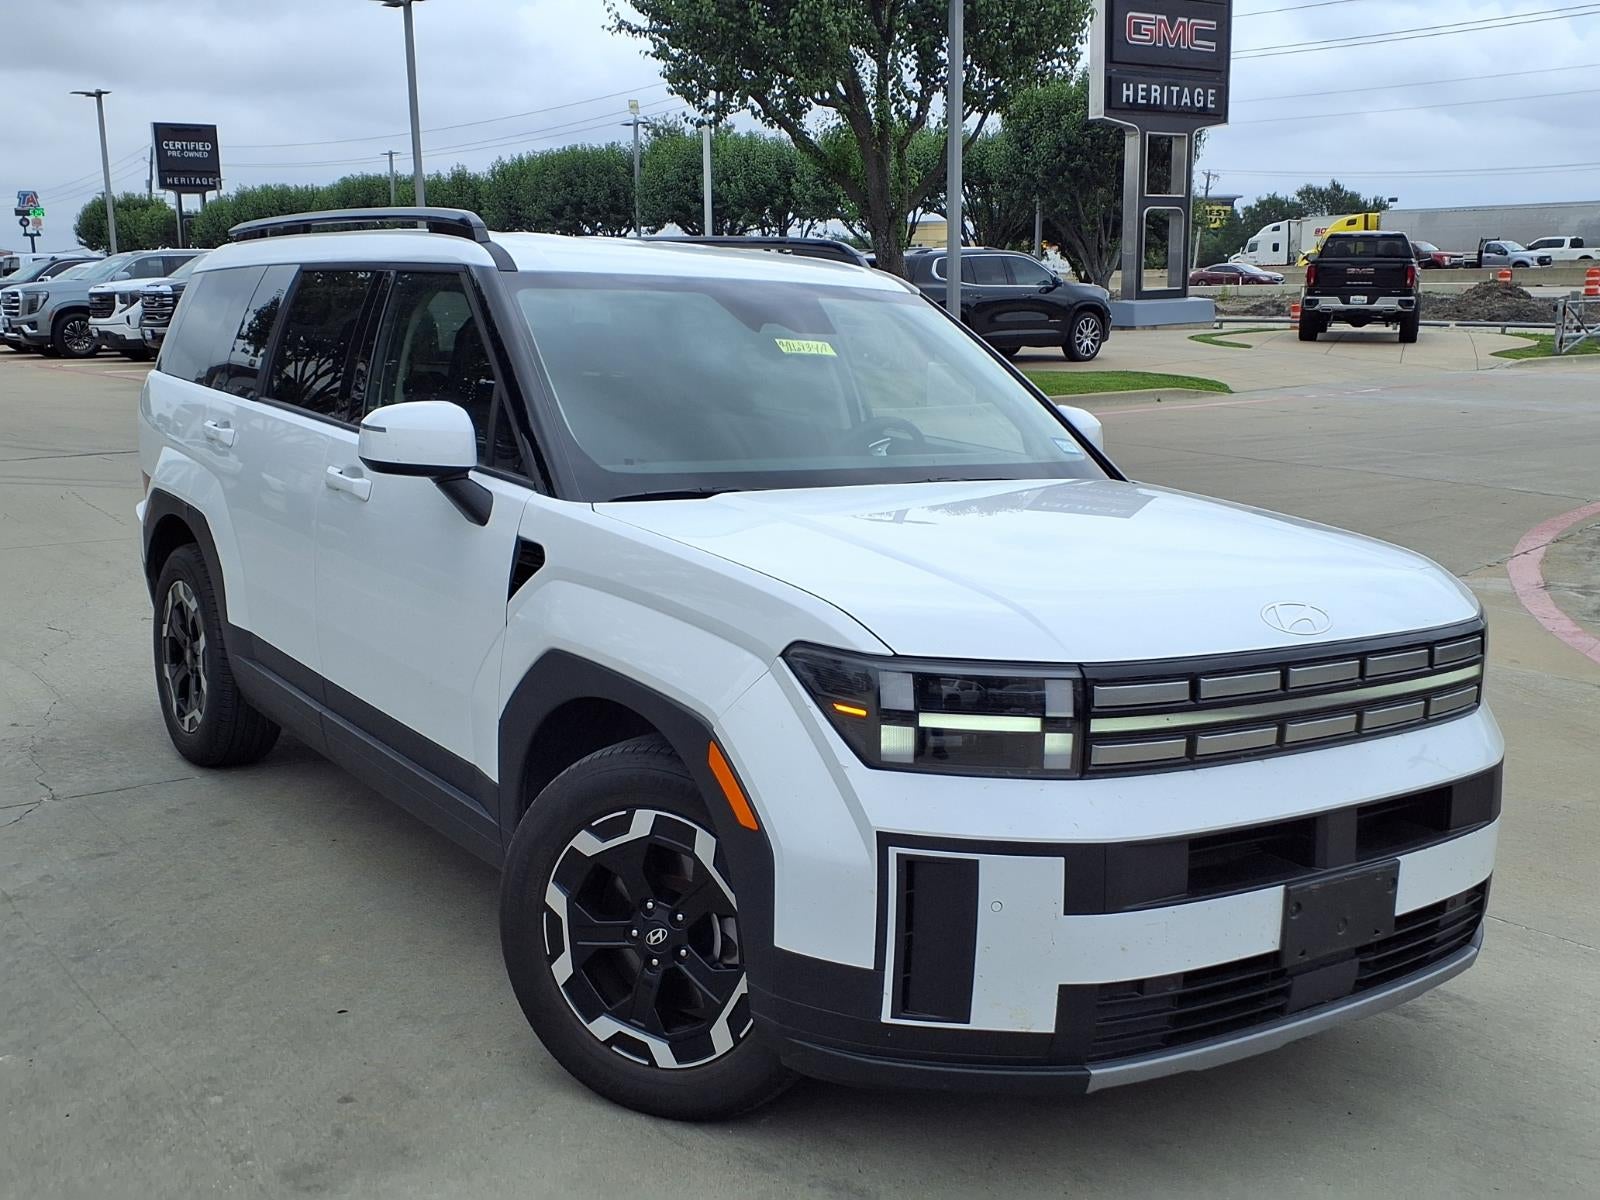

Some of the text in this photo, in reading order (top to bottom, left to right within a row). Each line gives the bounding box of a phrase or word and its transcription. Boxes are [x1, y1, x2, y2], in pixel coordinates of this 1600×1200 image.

[1126, 11, 1217, 52] GMC
[1122, 82, 1216, 109] HERITAGE
[162, 140, 212, 151] CERTIFIED
[167, 150, 209, 158] PRE-OWNED
[166, 176, 215, 185] HERITAGE
[17, 191, 40, 207] TA
